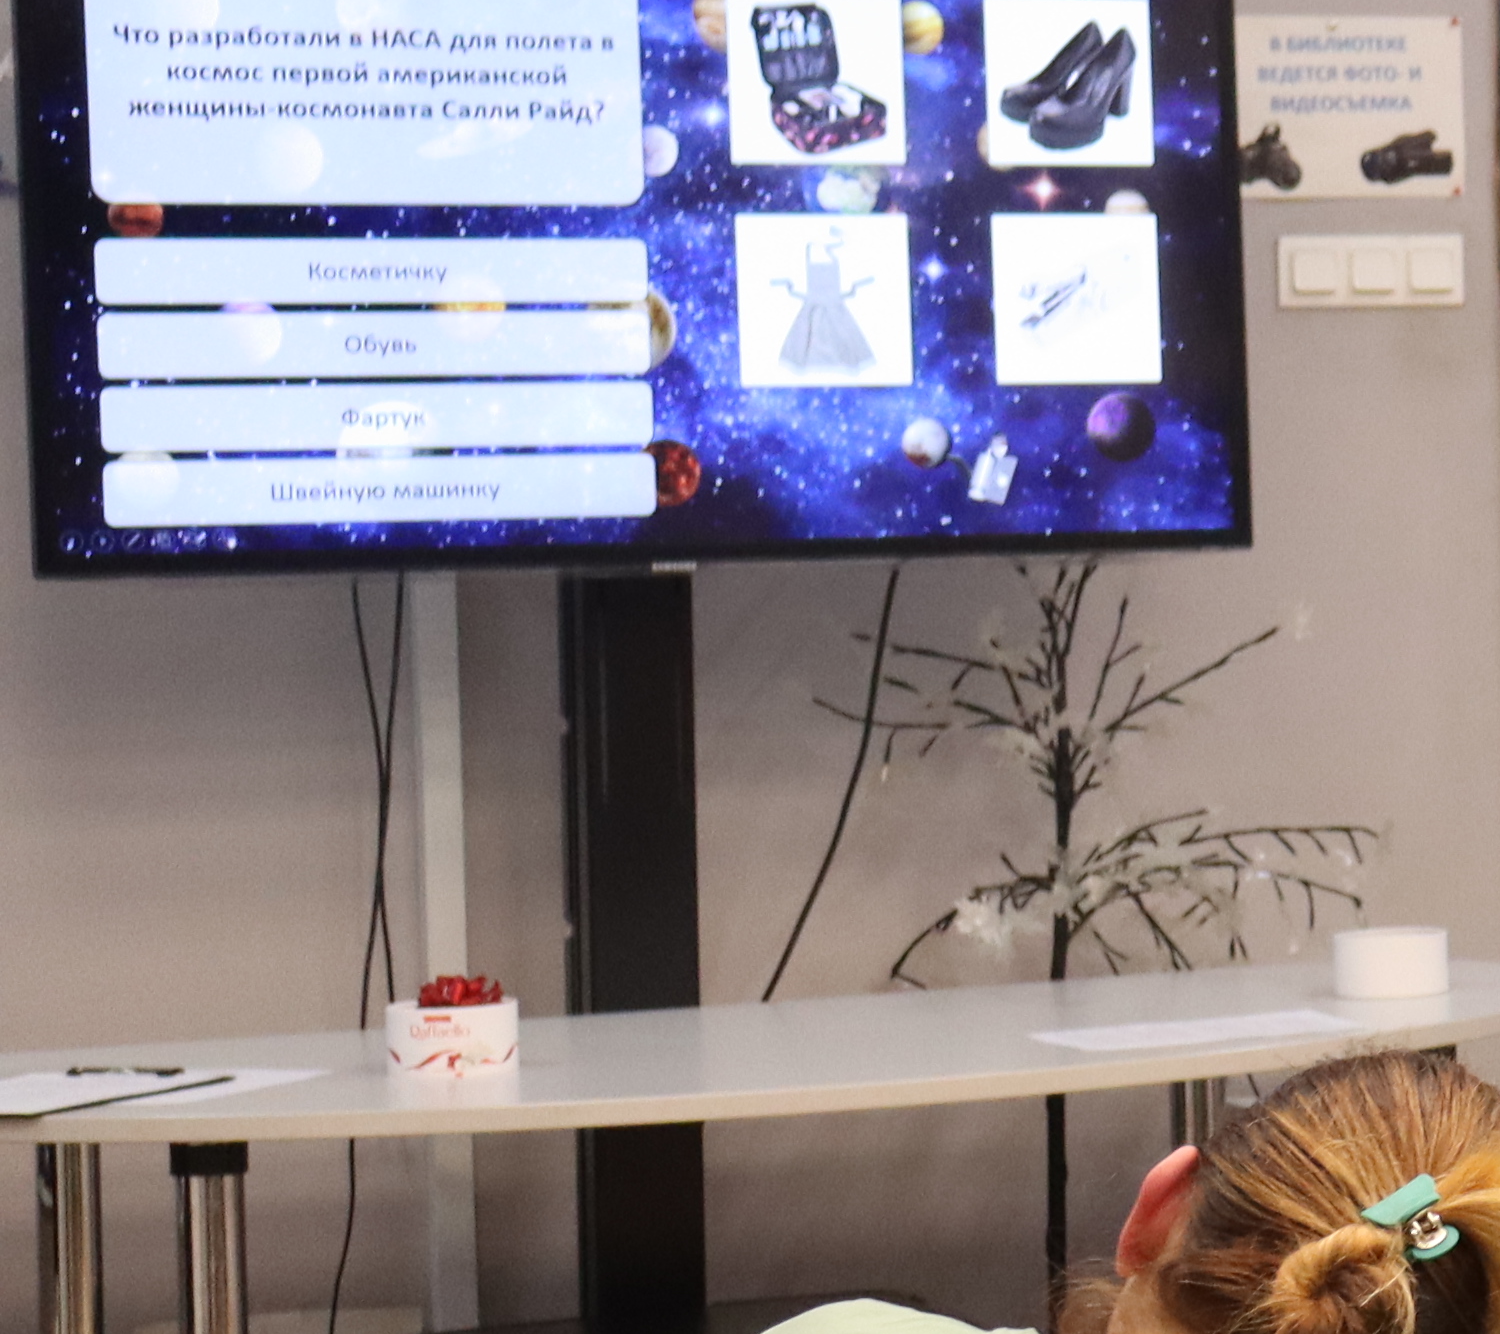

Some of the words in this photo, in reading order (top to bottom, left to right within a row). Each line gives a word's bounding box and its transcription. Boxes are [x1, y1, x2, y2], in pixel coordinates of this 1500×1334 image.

[113, 24, 160, 45] Что
[169, 25, 340, 50] разработали
[350, 31, 362, 47] в
[372, 28, 441, 49] НАСА
[449, 33, 496, 55] для
[506, 33, 593, 51] полета
[602, 35, 615, 52] в
[1286, 35, 1406, 52] БИБЛИОТЕКЕ
[167, 65, 264, 82] космос
[273, 61, 368, 87] первой
[378, 63, 567, 88] американской
[1408, 65, 1422, 81] И
[129, 100, 433, 122] женщины-космонавта
[442, 100, 520, 118] Салли
[529, 98, 605, 126] Райд?
[308, 261, 447, 284] Косметичку
[344, 333, 418, 357] Обувь
[341, 408, 426, 430] Фартук
[270, 480, 385, 505] Швейную
[394, 482, 501, 503] машинку
